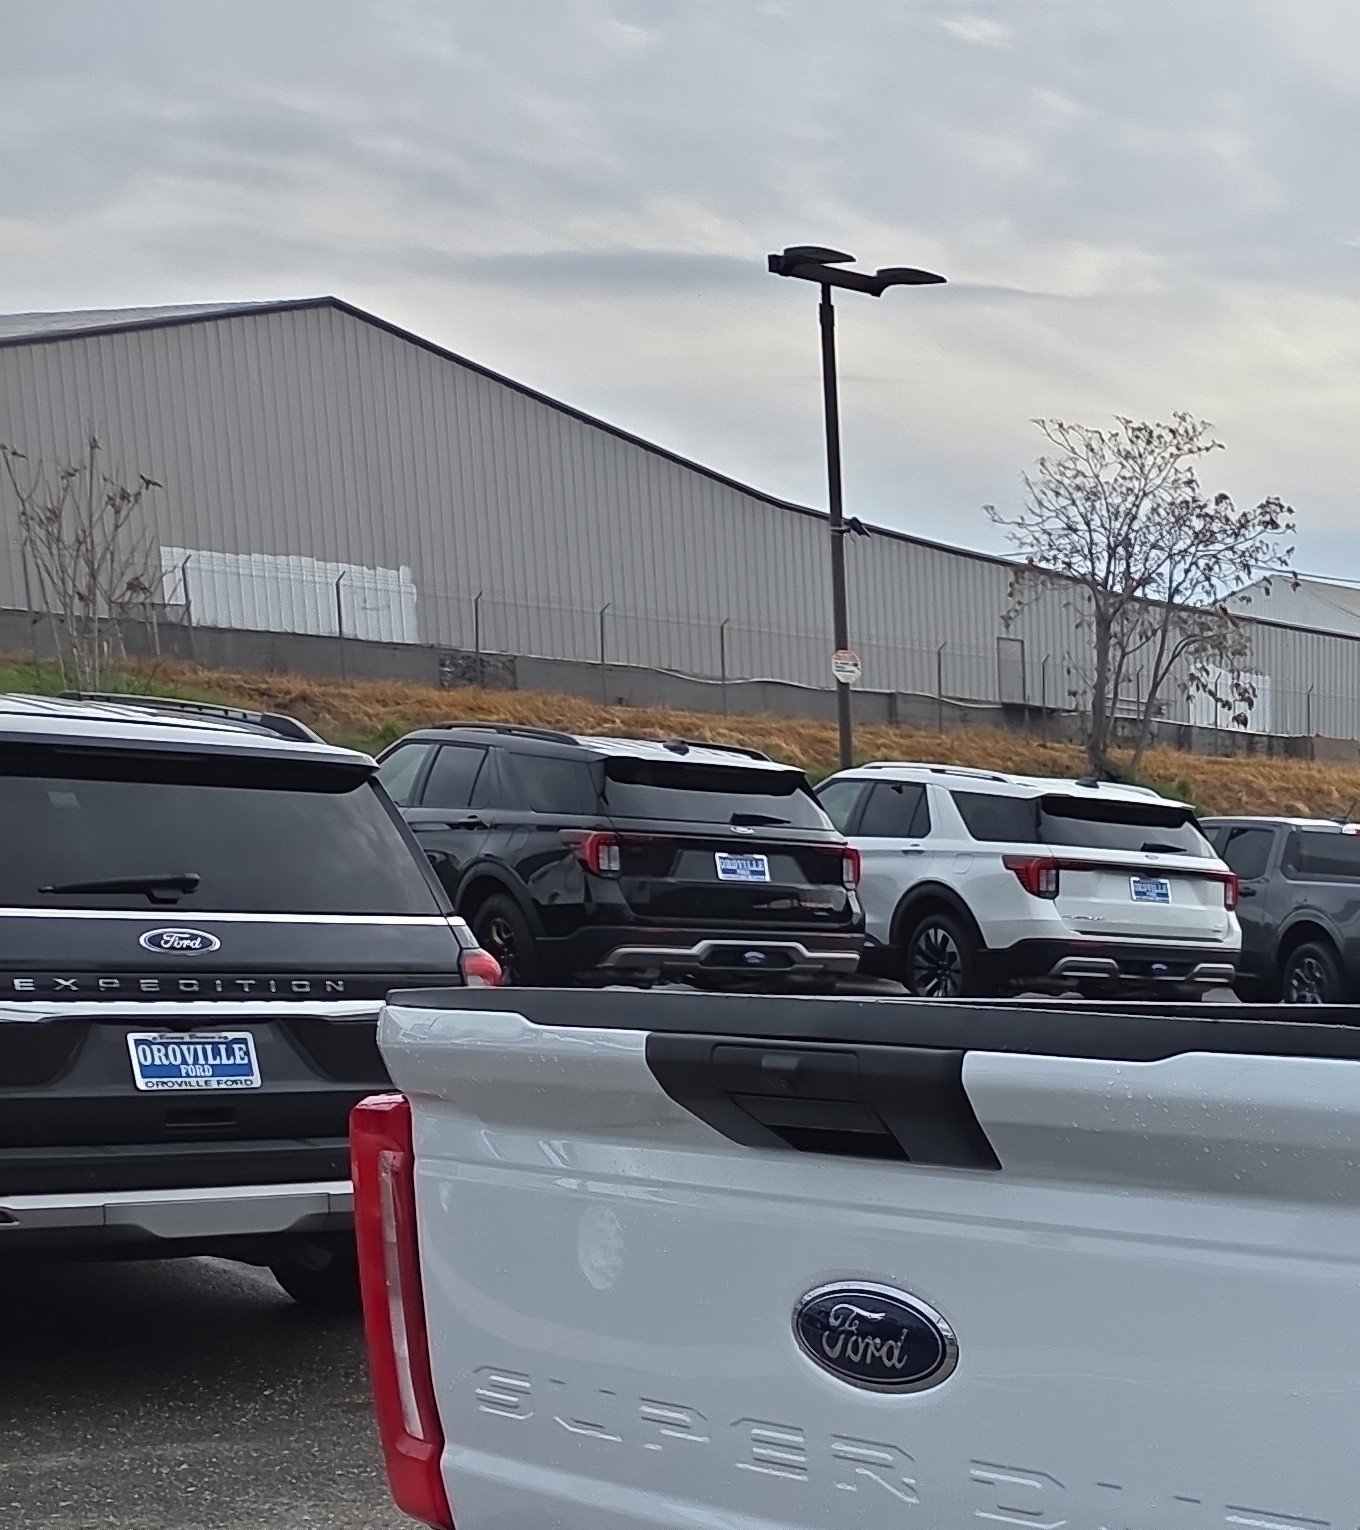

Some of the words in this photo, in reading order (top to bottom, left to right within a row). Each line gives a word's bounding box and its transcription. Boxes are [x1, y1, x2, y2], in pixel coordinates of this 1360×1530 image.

[161, 932, 202, 949] Ford
[13, 978, 345, 993] EXPEDITION
[137, 1043, 249, 1066] OROVILLE
[180, 1064, 213, 1077] FORD
[145, 1079, 213, 1089] OROVILLE
[216, 1079, 254, 1087] FORD
[822, 1303, 908, 1369] Ford
[474, 1365, 918, 1504] SUPER
